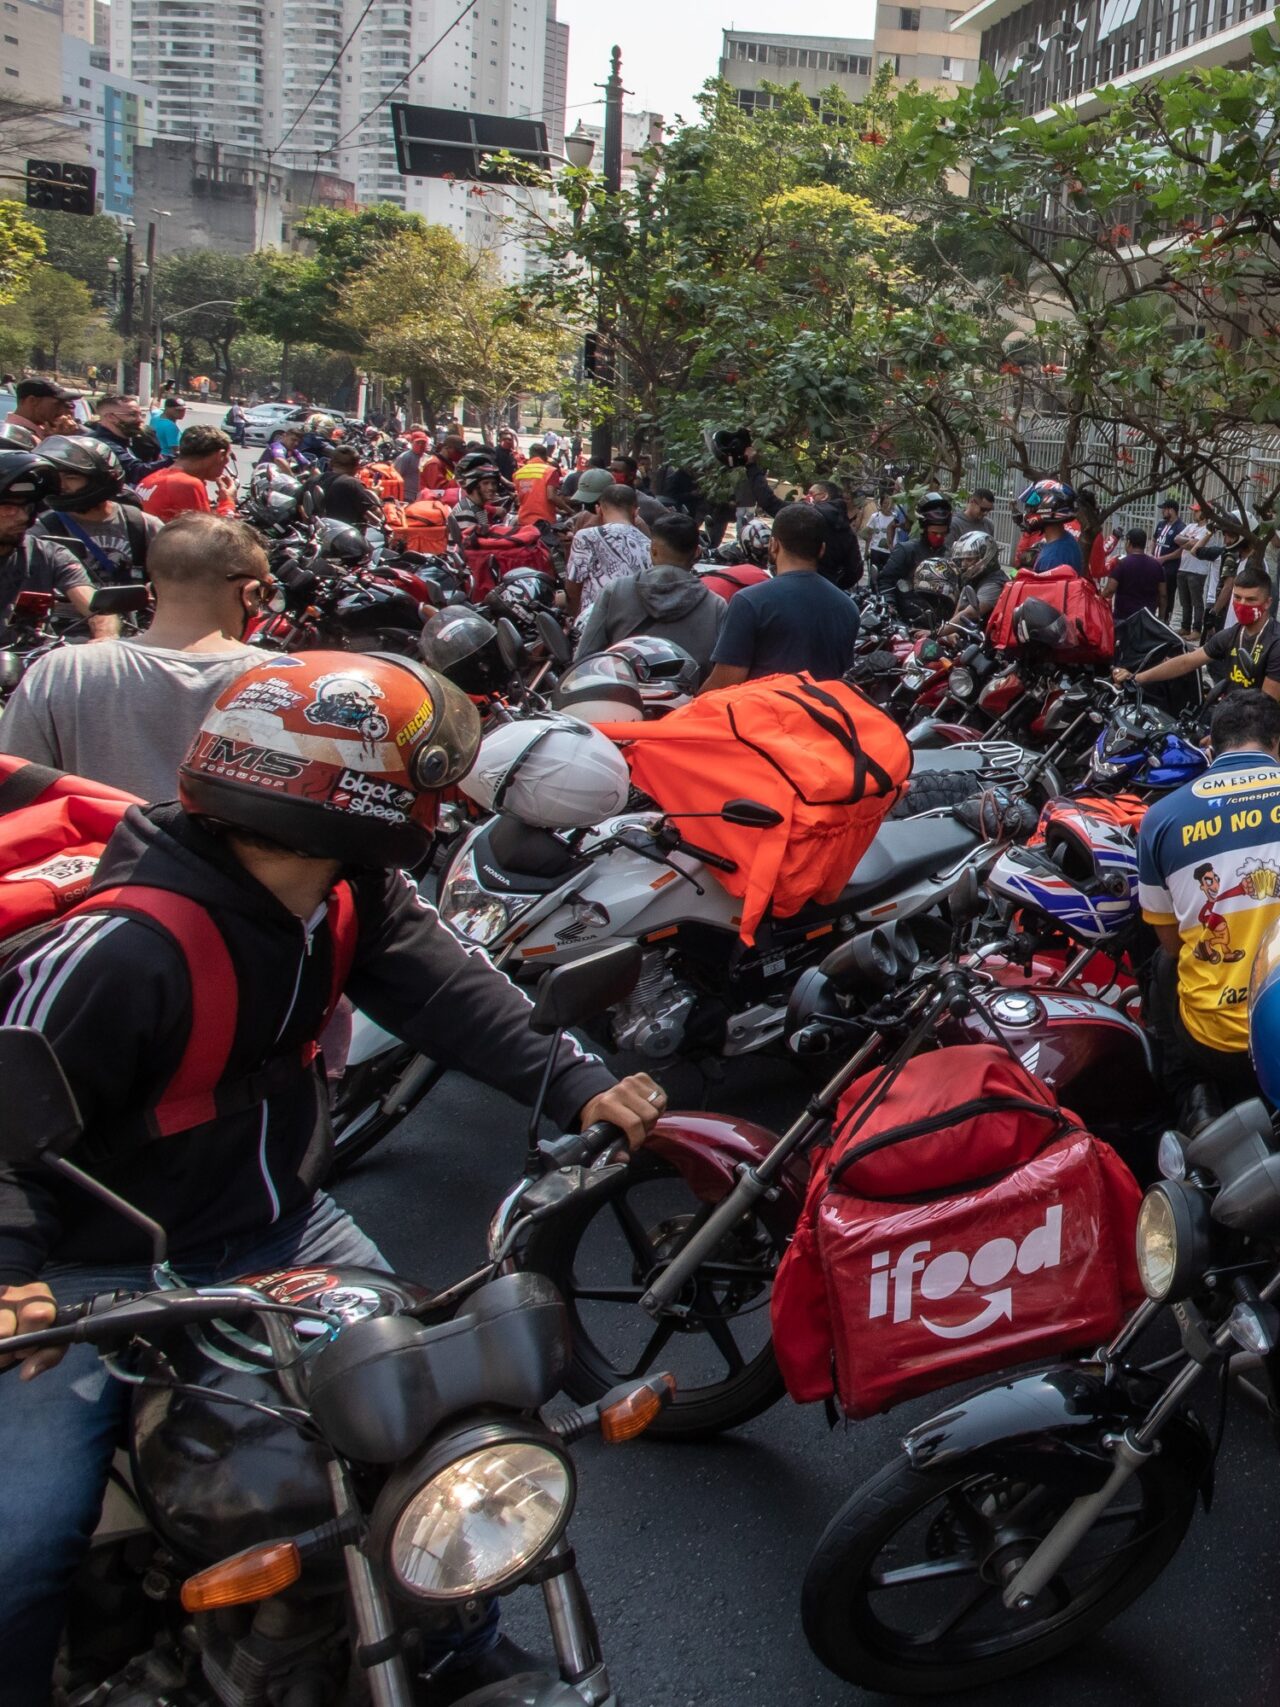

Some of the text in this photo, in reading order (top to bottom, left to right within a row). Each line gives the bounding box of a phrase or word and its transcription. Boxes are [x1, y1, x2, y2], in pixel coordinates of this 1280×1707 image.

[338, 770, 398, 804] black
[348, 794, 406, 826] sheep
[1182, 815, 1222, 847] PAU
[1231, 808, 1263, 833] NO
[483, 864, 511, 886] HONDA
[556, 933, 598, 946] HONDA
